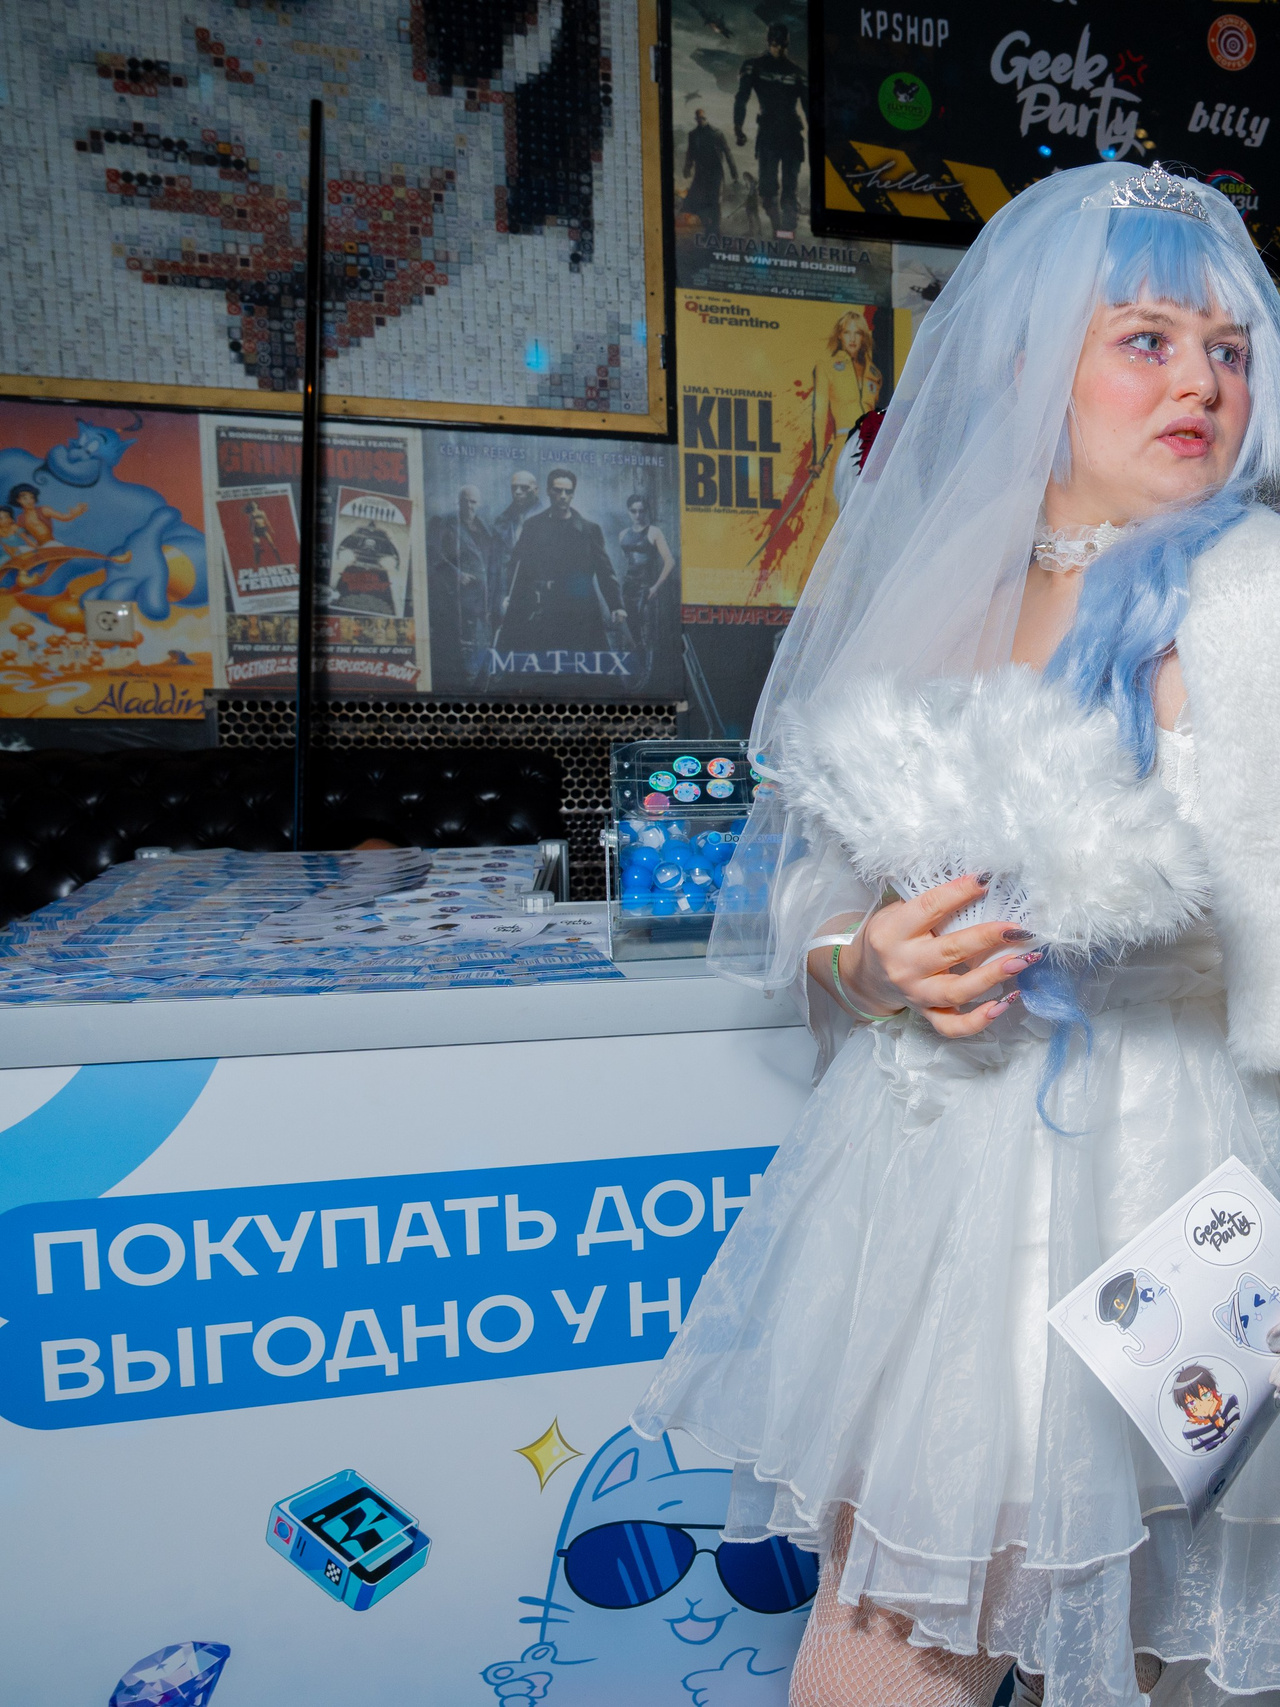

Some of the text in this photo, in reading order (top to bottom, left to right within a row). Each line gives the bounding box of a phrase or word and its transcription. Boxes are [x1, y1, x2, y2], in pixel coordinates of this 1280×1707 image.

[860, 7, 950, 48] KPSHOP
[990, 22, 1109, 91] Geek
[1016, 72, 1146, 161] Party
[694, 233, 779, 255] CAPTAIN
[784, 242, 872, 264] AMERICA
[712, 251, 857, 274] THE WINTER SOLDIER
[684, 300, 751, 316] Quentin
[698, 313, 780, 330] Tarantino
[683, 385, 773, 398] UMA THURMAN
[683, 394, 781, 453] KILL
[439, 446, 666, 468] KEANU REEVES LAURENCE FISHBURNE
[684, 452, 782, 509] BILL
[238, 563, 297, 580] PLANET
[489, 648, 632, 676] MATRIX
[74, 681, 206, 715] Aladdin
[33, 1192, 557, 1296] ПОКУПАТЬ
[1193, 1208, 1228, 1247] Geek
[1209, 1210, 1256, 1252] Party
[41, 1275, 705, 1402] ВЫГОДНО У Н
